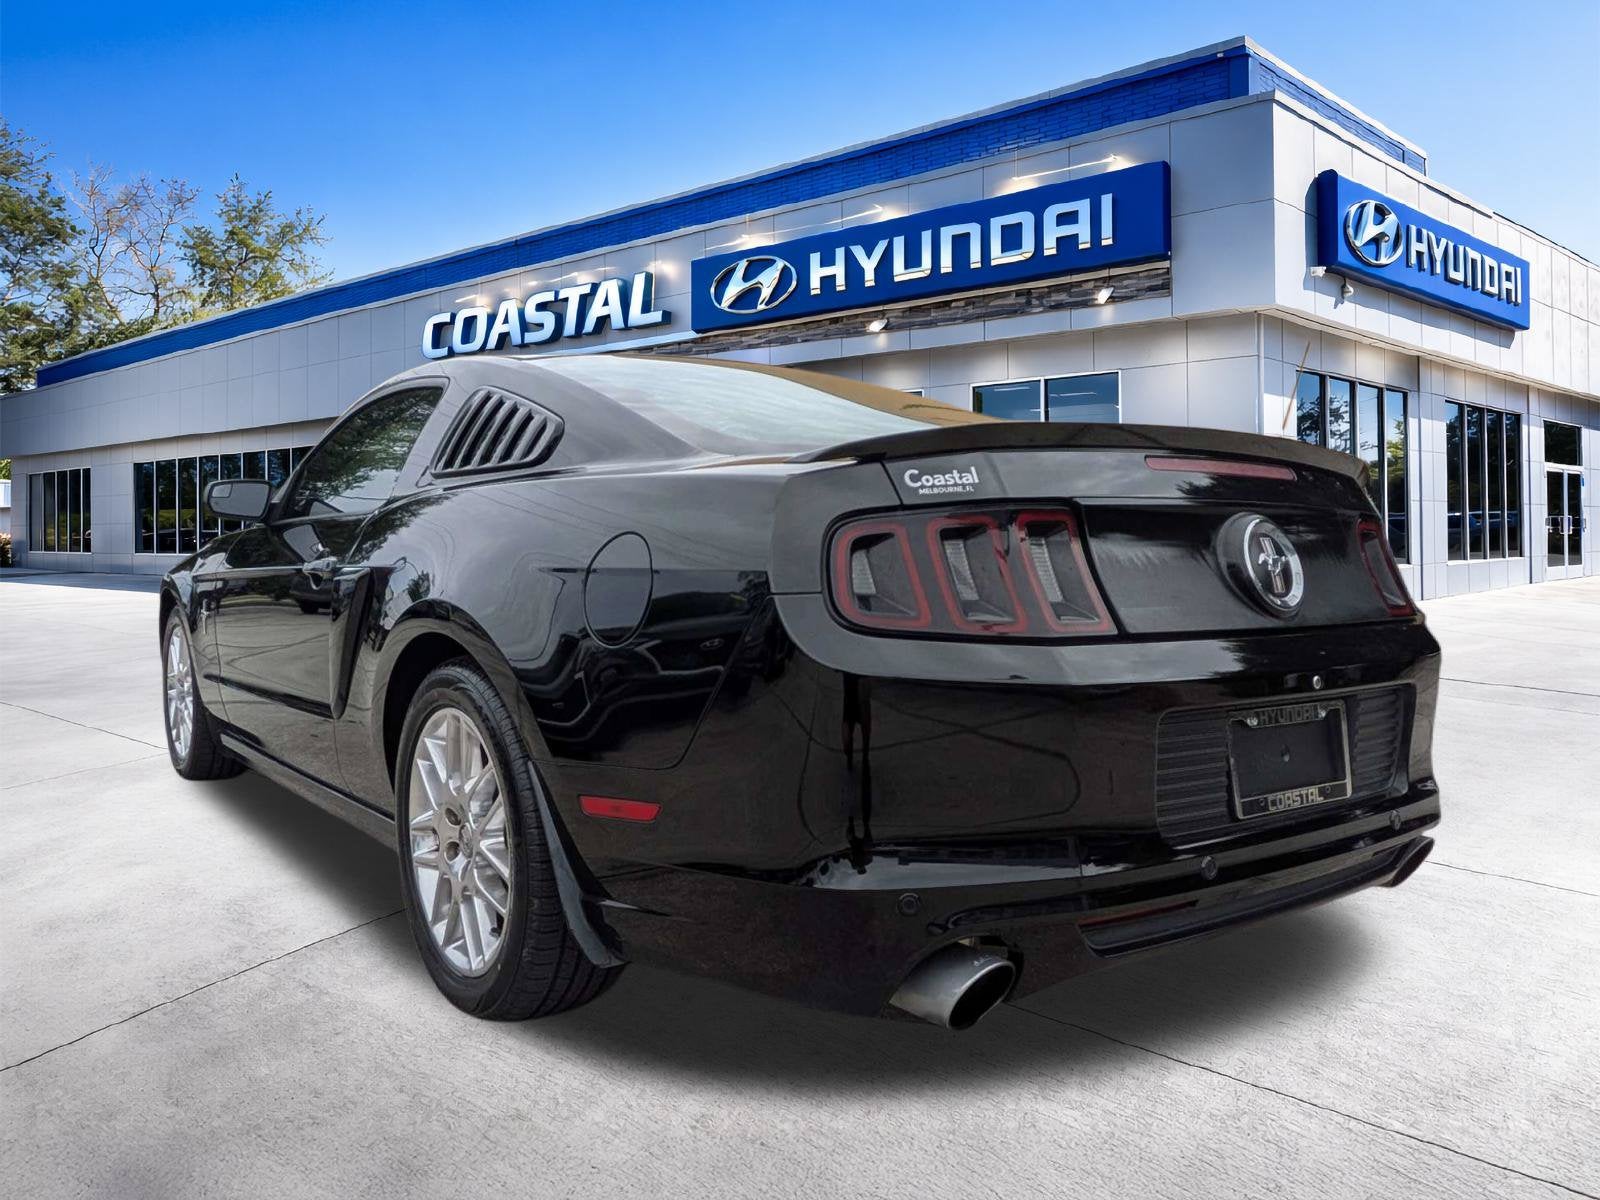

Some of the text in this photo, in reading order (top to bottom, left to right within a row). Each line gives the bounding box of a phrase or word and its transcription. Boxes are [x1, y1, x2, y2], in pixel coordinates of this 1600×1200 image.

[808, 192, 1115, 296] HYUNDAI
[1406, 225, 1521, 306] HYUNDAI
[421, 271, 667, 359] COASTAL
[903, 466, 979, 487] Coastal
[1259, 704, 1315, 724] HYUNDAI
[1267, 787, 1324, 811] COASTAL
